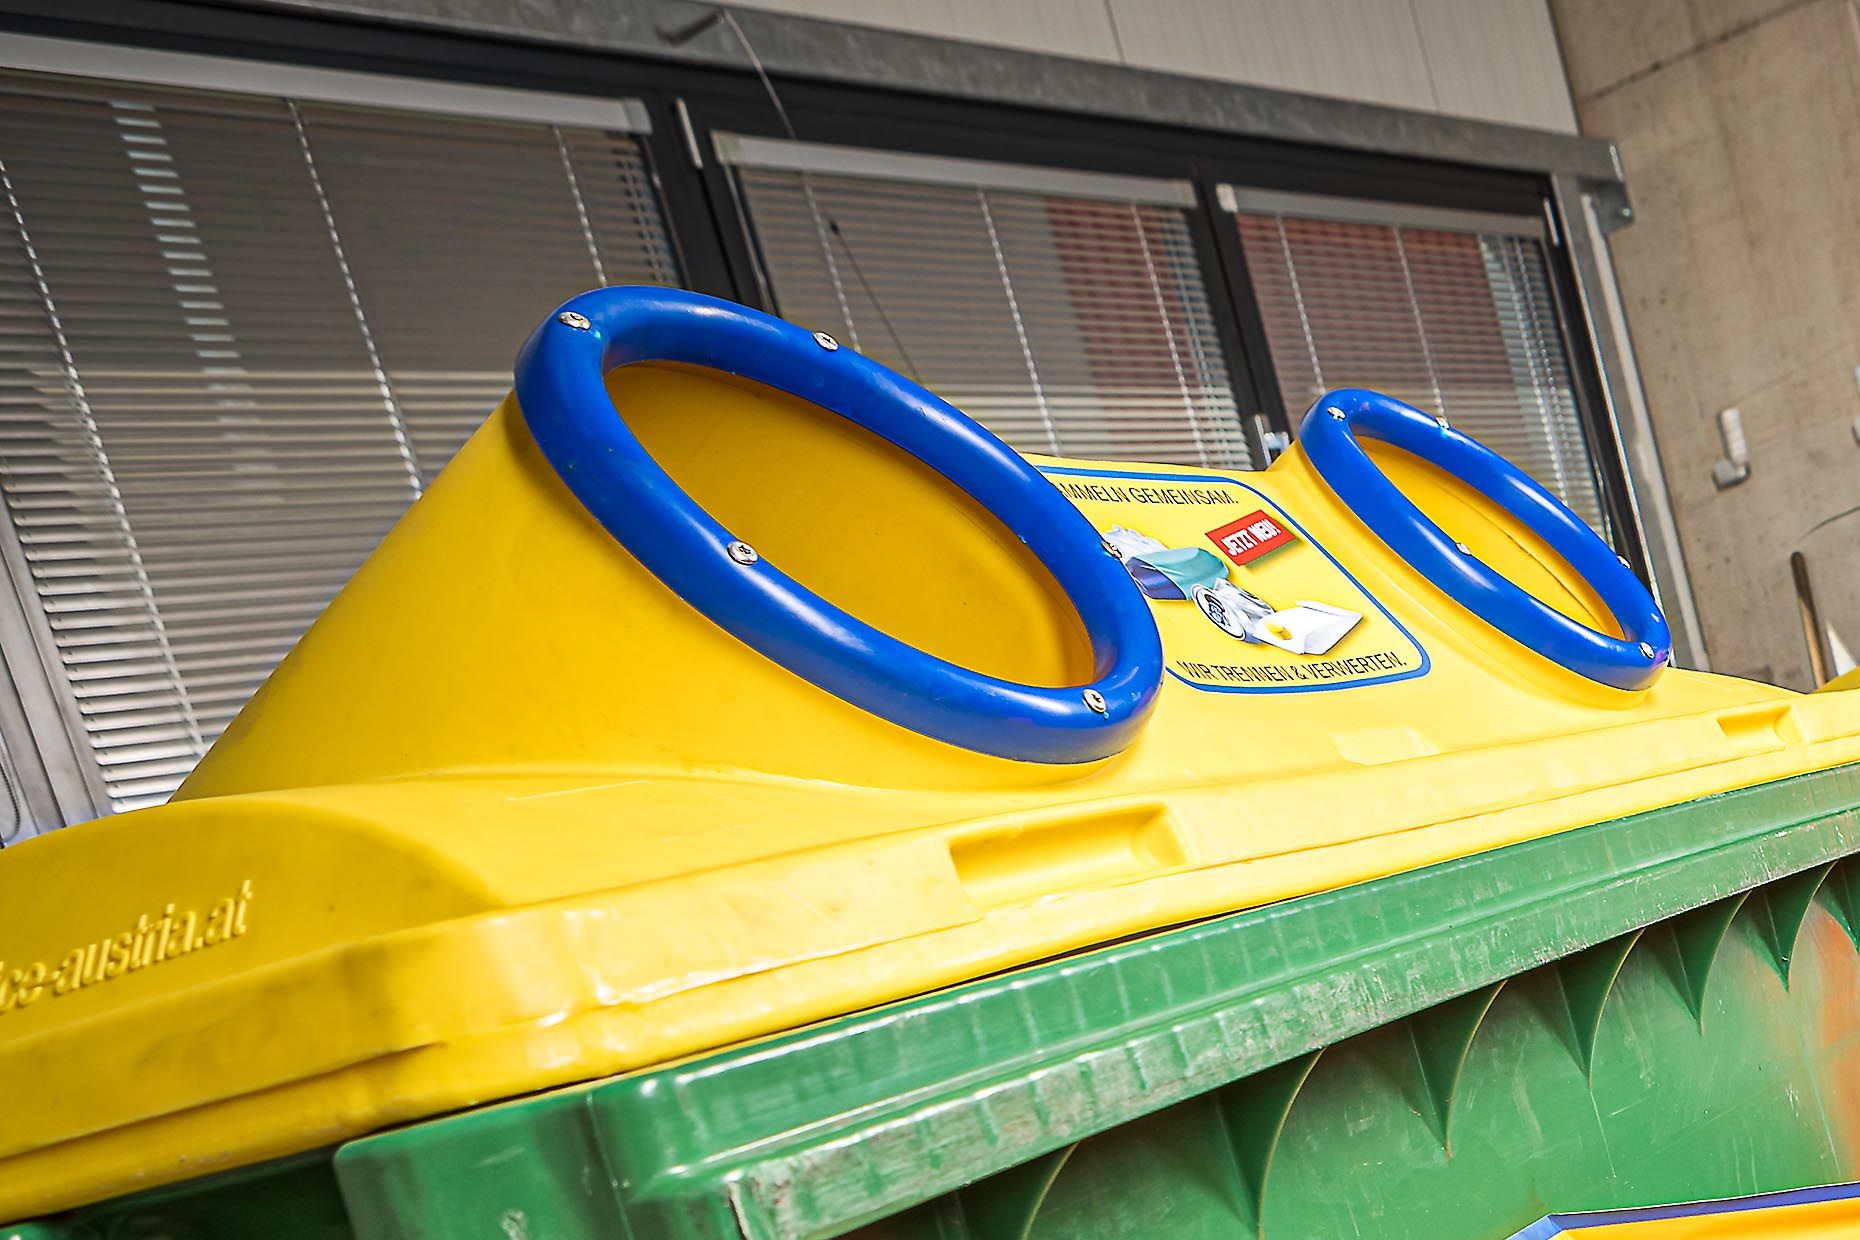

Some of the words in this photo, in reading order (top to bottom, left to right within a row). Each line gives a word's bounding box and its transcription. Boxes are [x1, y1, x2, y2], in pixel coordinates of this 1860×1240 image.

[1129, 487, 1239, 505] GEMEINSAM.
[1220, 528, 1259, 556] JETZT
[1247, 518, 1282, 542] NEU!
[1176, 660, 1219, 680] WIR
[1211, 664, 1294, 682] TRENNEN
[1292, 665, 1308, 680] &
[1302, 651, 1407, 680] VERWERTEN.
